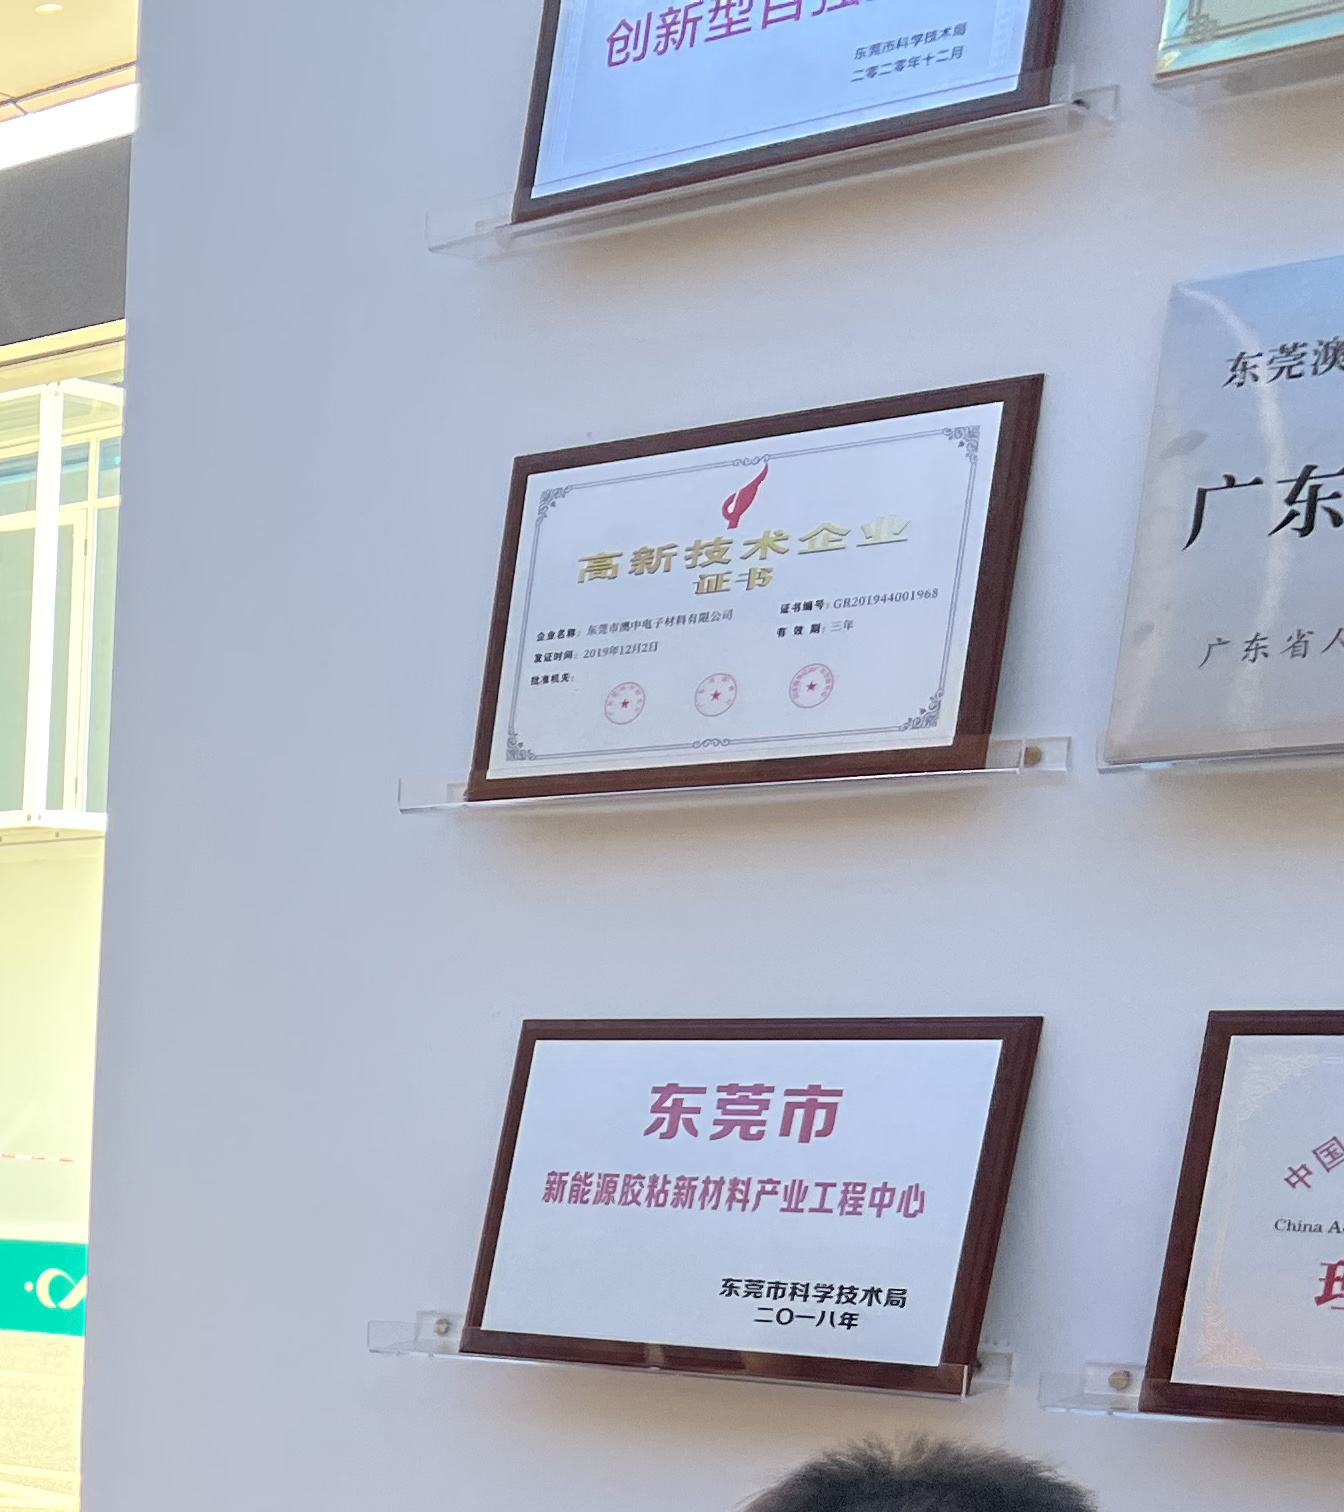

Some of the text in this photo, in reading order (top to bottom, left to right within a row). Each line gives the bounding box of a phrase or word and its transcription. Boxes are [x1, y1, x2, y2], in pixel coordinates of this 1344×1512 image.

[854, 22, 967, 60] 东莞市科学技术局
[850, 46, 964, 82] 二零二零年十二月
[1182, 463, 1344, 551] 广东
[578, 514, 911, 583] 高新技术企业
[693, 567, 774, 595] 证书
[833, 588, 939, 609] GR201944001968
[586, 608, 733, 637] 东莞市澳中电子材料有限公司
[830, 619, 854, 633] 三年
[583, 641, 659, 659] 2019年12月2日
[643, 1083, 844, 1143] 东莞市
[1284, 1136, 1344, 1193] 中国
[542, 1169, 926, 1219] 新能源胶粘新材料产业工程中心
[1274, 1217, 1344, 1235] China A
[719, 1276, 907, 1309] 东莞市科学技术局
